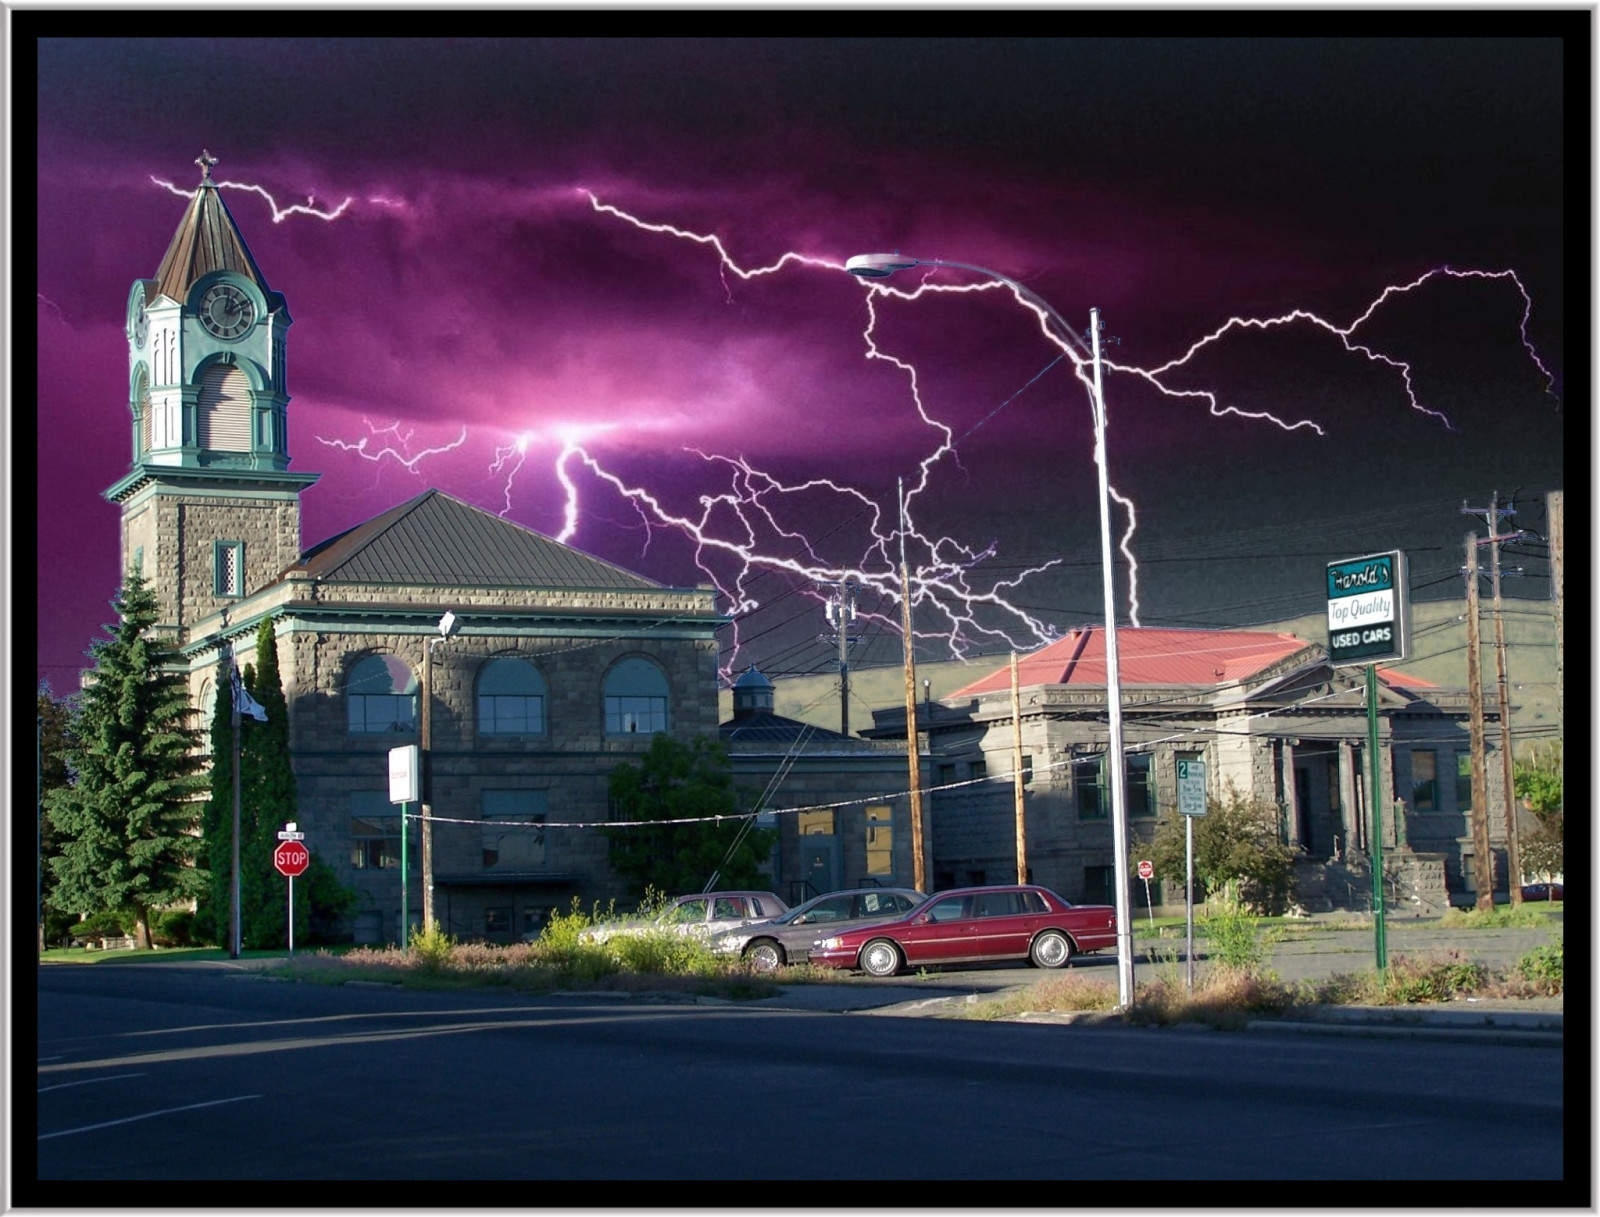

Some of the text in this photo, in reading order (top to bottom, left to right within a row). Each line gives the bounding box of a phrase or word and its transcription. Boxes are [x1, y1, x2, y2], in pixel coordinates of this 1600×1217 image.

[1331, 563, 1389, 591] Harold's
[1330, 596, 1391, 623] Top Quality
[1332, 628, 1391, 649] USED CARS
[1179, 762, 1186, 777] 2
[278, 852, 306, 865] STOP
